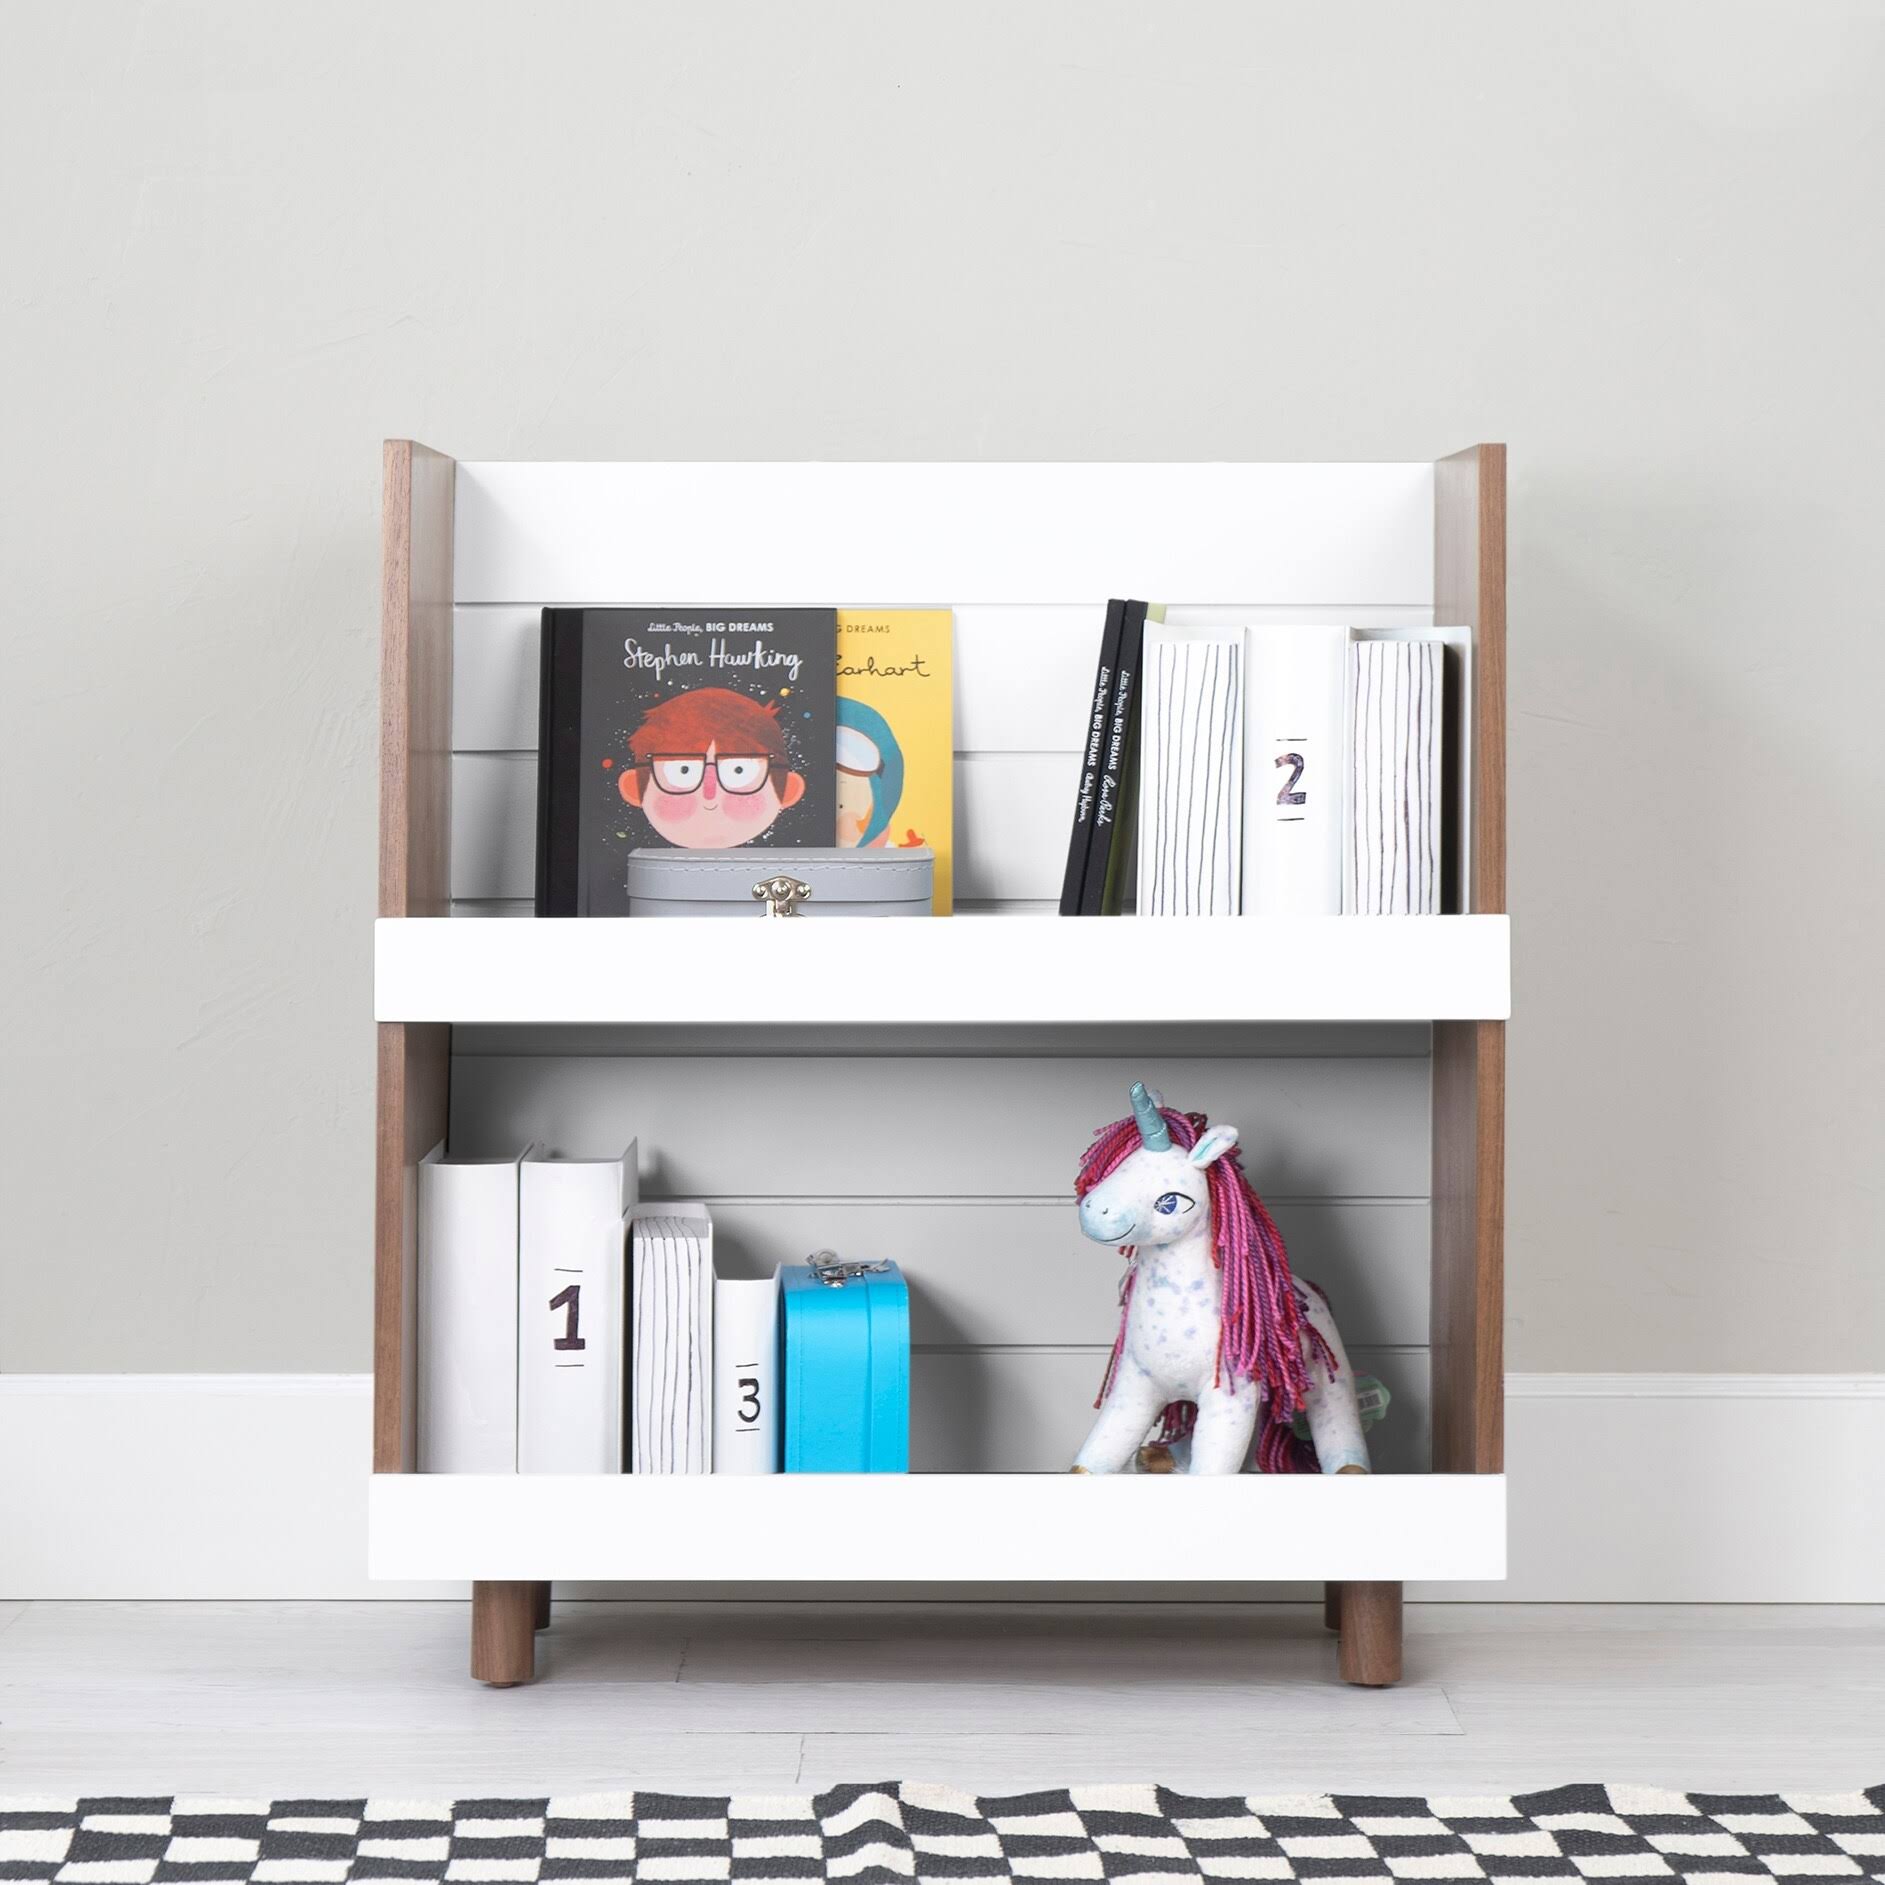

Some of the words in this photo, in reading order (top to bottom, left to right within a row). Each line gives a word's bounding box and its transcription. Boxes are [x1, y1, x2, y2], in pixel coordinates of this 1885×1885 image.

[648, 622, 672, 632] Little
[705, 622, 726, 632] BIG
[728, 622, 774, 632] DREAMS
[846, 624, 891, 634] DREAMS
[623, 637, 703, 681] Stephen
[708, 637, 803, 681] Hawking
[1092, 714, 1104, 730] BIG
[1112, 717, 1124, 734] BIG
[1087, 731, 1101, 767] DREAMS
[1107, 735, 1121, 770] DREAMS
[1101, 774, 1117, 800] Rosa
[1275, 752, 1307, 805] 2
[1096, 800, 1113, 827] Parks
[548, 1284, 586, 1351] 1
[737, 1377, 761, 1423] 3
